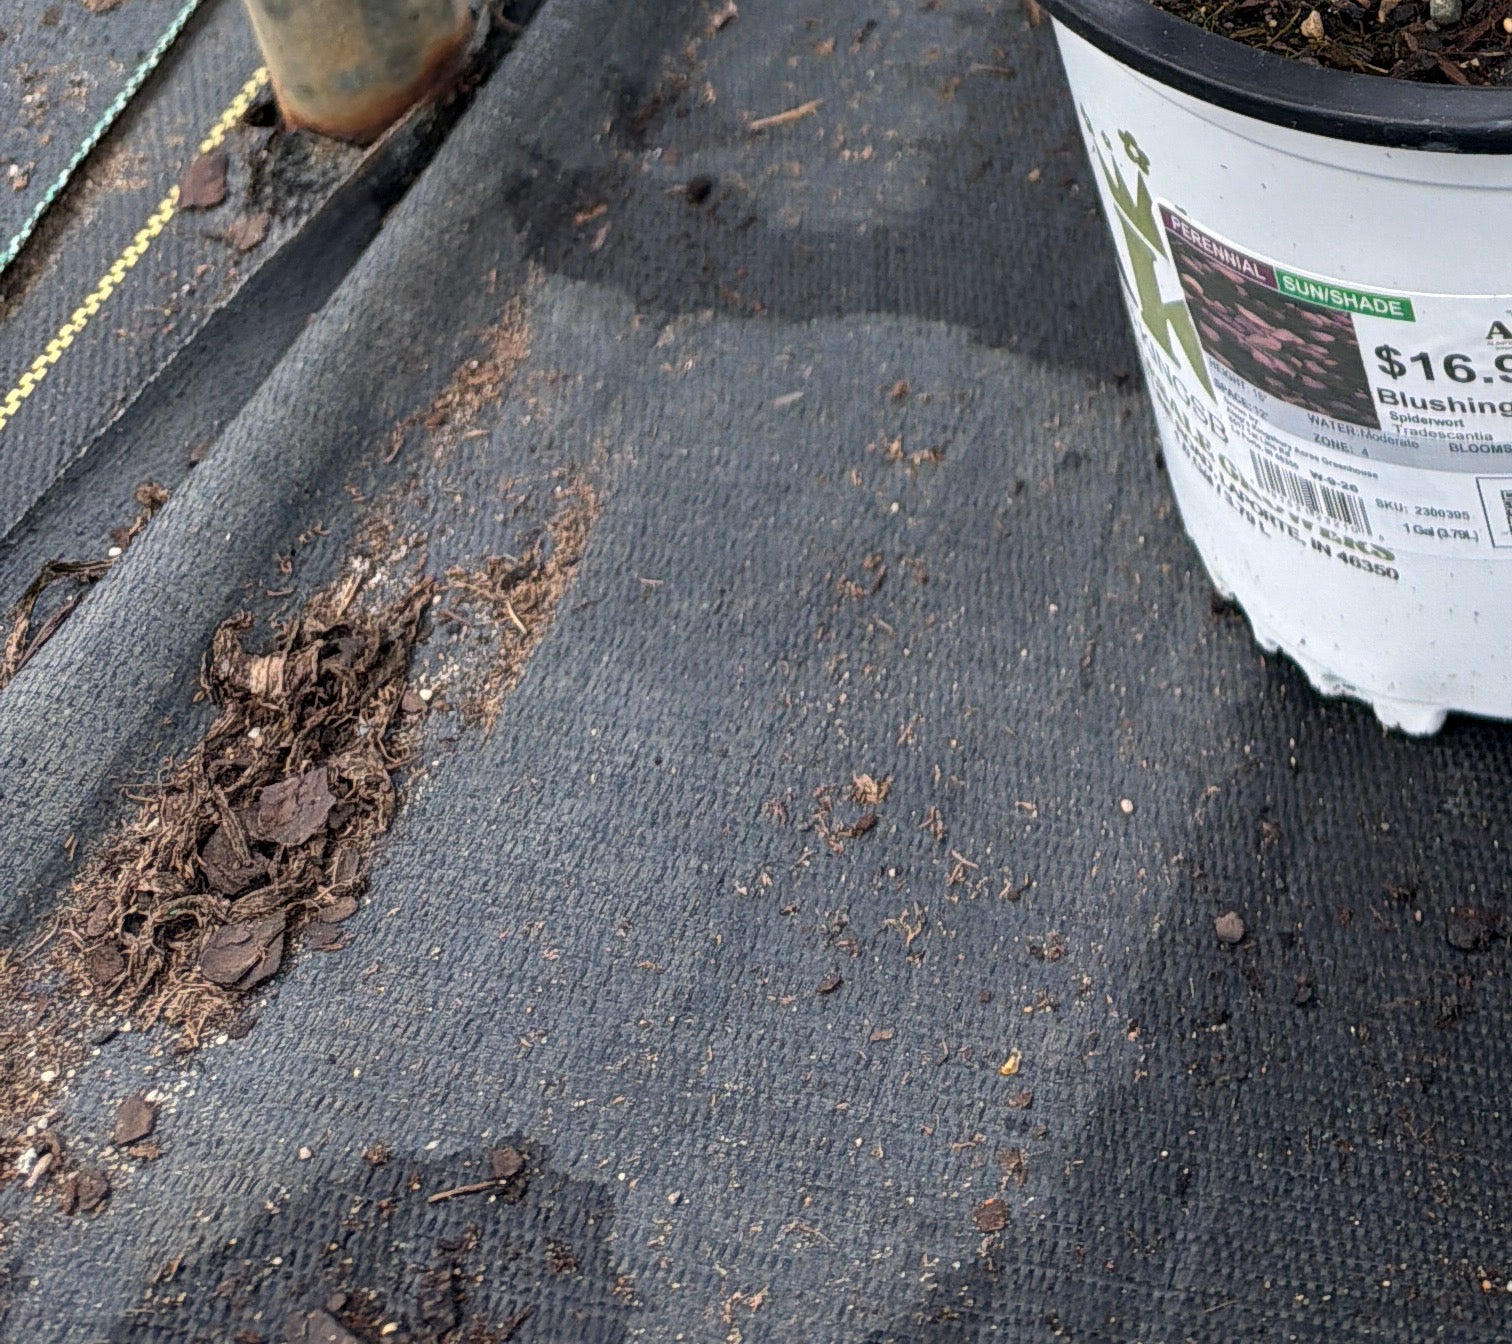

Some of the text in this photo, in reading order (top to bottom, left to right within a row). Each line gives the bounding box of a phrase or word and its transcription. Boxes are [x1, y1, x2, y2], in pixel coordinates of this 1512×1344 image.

[1169, 214, 1267, 282] PERENNIAL
[1281, 274, 1406, 318] SUN/SHADE
[1388, 410, 1465, 428] Spiderwort
[1392, 423, 1494, 442] Tradescantia
[1336, 549, 1400, 582] 46350
